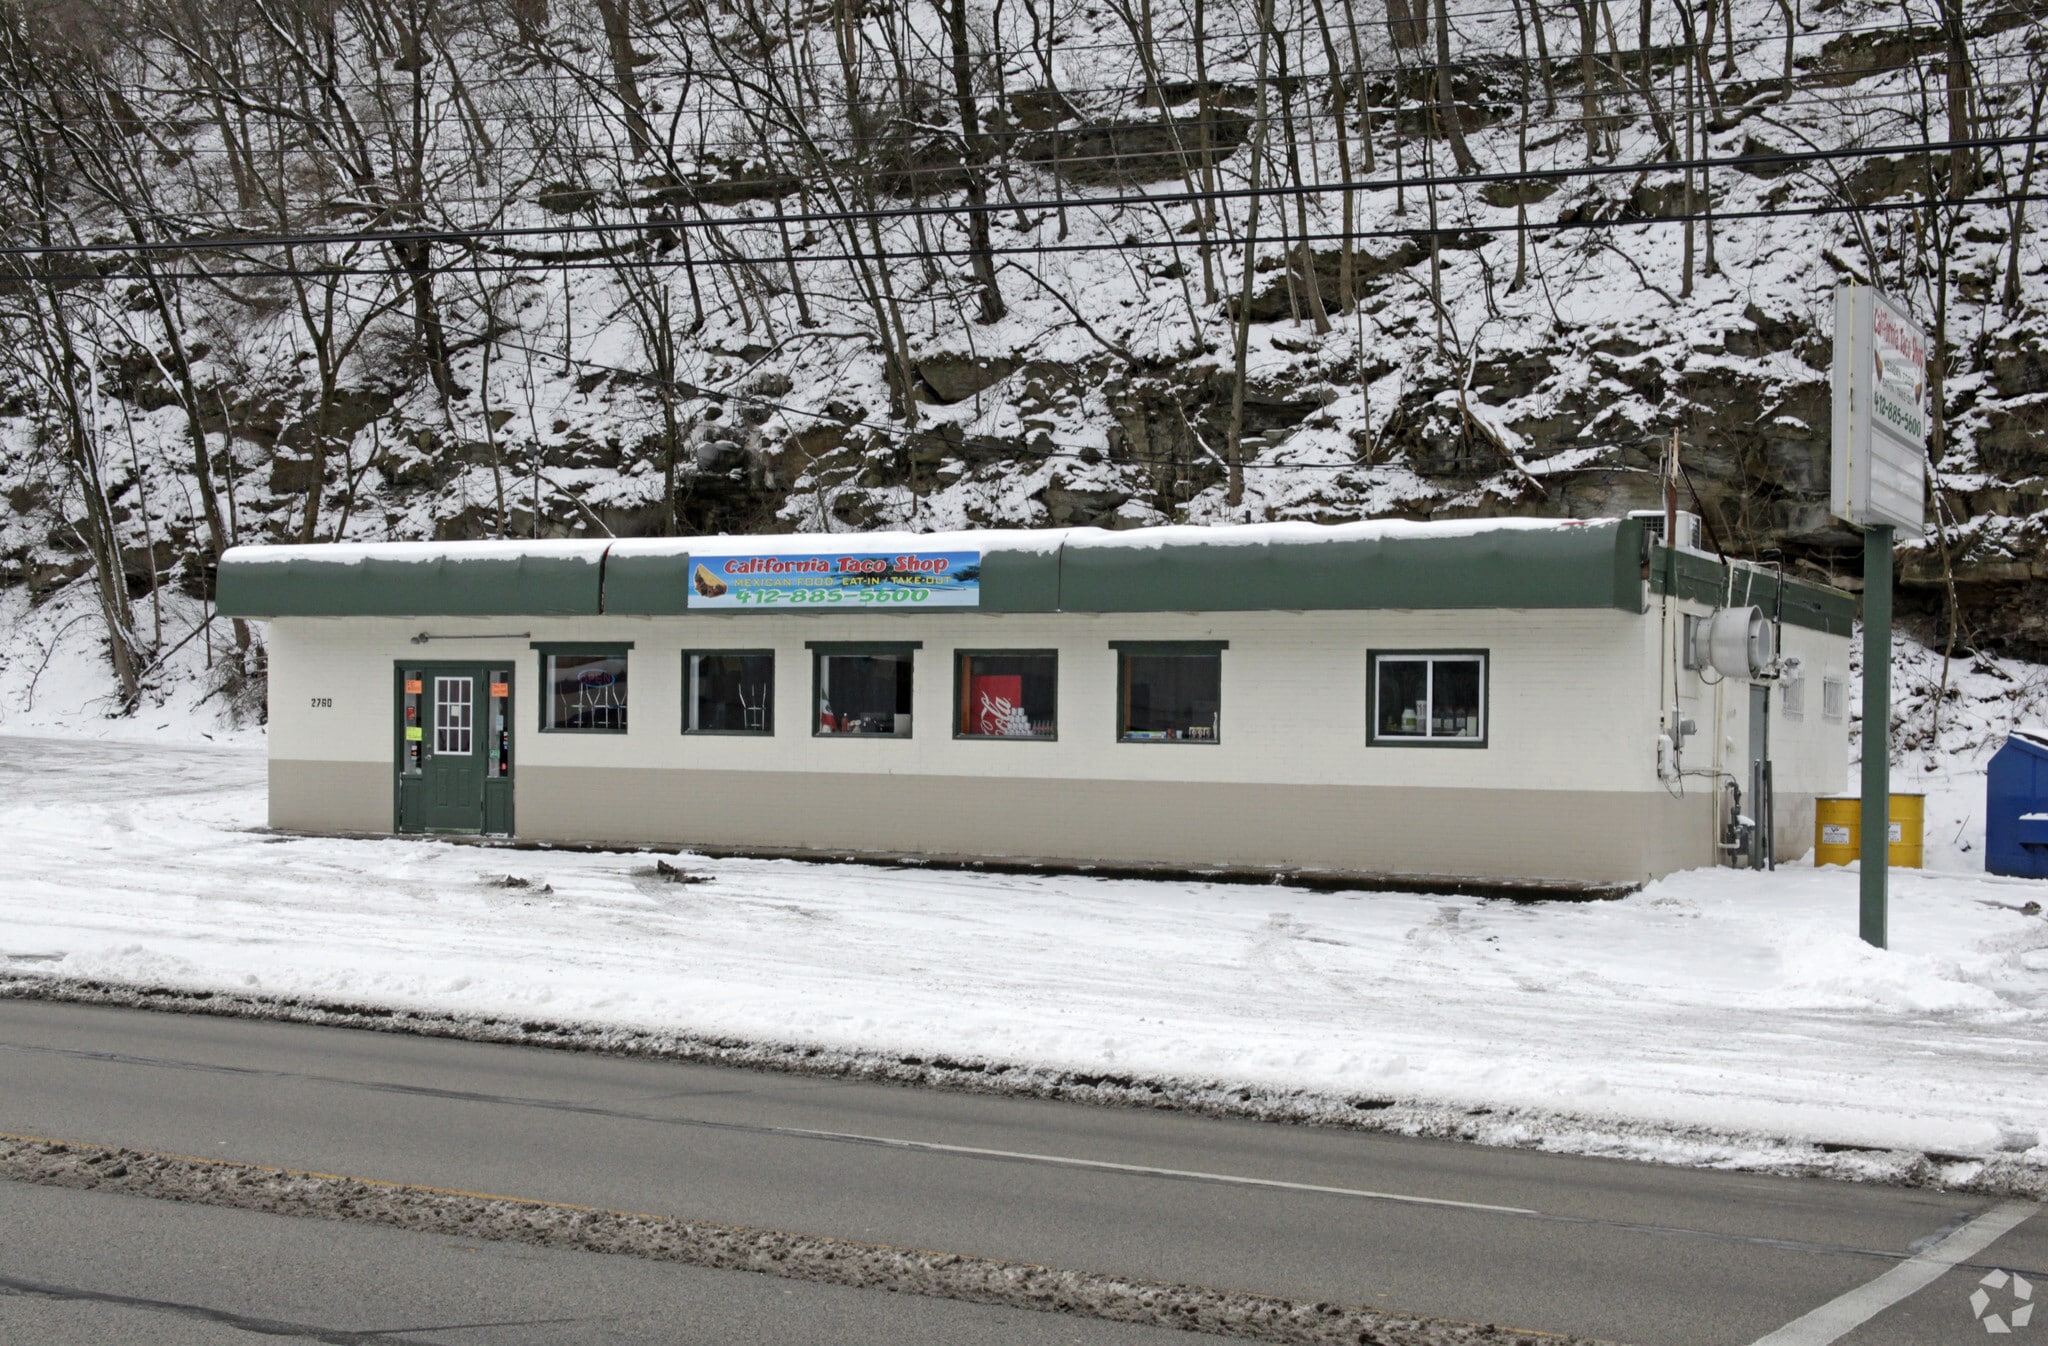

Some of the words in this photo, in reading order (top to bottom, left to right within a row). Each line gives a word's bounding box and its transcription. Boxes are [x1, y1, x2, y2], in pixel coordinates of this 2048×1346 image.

[1874, 391, 1922, 438] 412-885-5600
[724, 558, 829, 574] California
[837, 557, 886, 573] Taco
[894, 554, 949, 574] Shop
[735, 578, 792, 587] MEXICAN
[797, 577, 834, 586] FOOD
[842, 576, 880, 586] EAT-IN
[891, 575, 952, 585] TAKE-OUT
[735, 587, 931, 604] 412-885-5600
[311, 698, 333, 708] 2760
